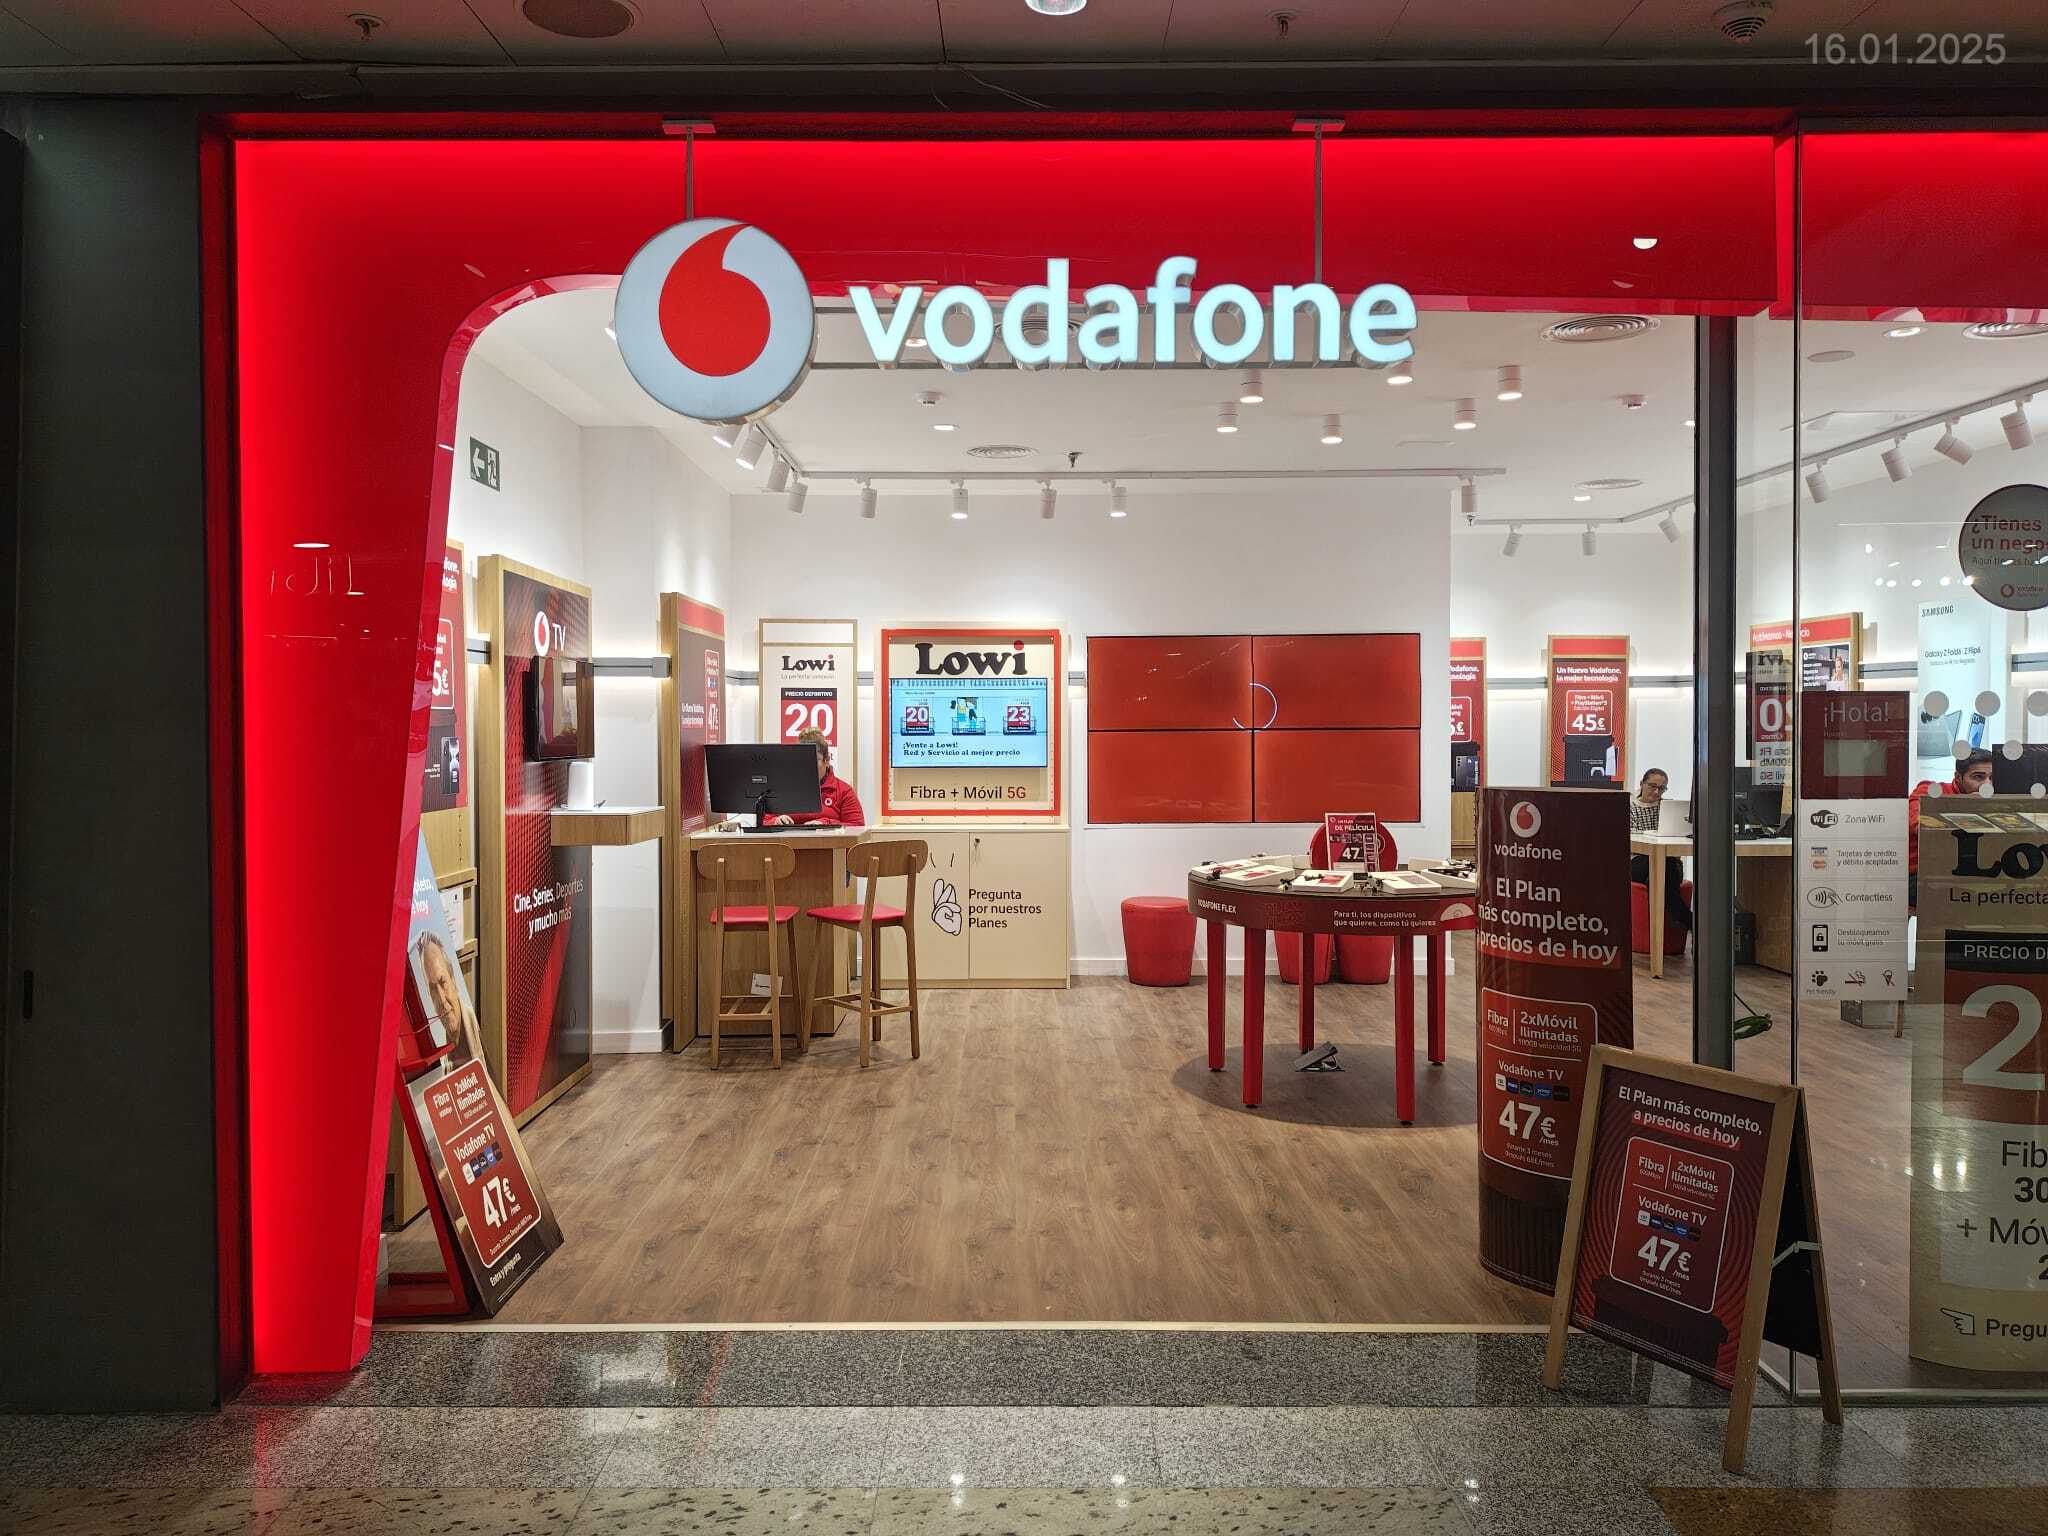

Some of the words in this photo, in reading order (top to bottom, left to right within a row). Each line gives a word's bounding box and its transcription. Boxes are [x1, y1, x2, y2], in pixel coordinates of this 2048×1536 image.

[847, 256, 1418, 368] vodafone
[1971, 515, 2042, 534] ¿Tienes
[1971, 537, 1994, 550] un
[1921, 604, 1954, 618] SAMSUNG
[551, 622, 566, 651] TV
[914, 639, 1029, 676] Lowi
[1924, 648, 1943, 658] Galaxy
[781, 654, 835, 671] Lowi
[1556, 666, 1567, 674] Un
[1567, 666, 1589, 674] Nuevo
[1589, 666, 1622, 675] Vodafone,
[1563, 674, 1583, 683] mejor
[1584, 674, 1619, 683] tecnología
[784, 703, 834, 738] 20
[906, 706, 930, 722] 20
[1008, 706, 1031, 722] 23
[1572, 713, 1606, 732] 45€
[1824, 701, 1889, 728] ¡Hola!
[903, 741, 928, 750] ¡Vente
[936, 741, 959, 749] Lowi!
[903, 749, 919, 757] Red
[920, 750, 926, 758] y
[927, 749, 960, 757] Servicio
[961, 749, 969, 757] al
[971, 749, 994, 759] mejor
[995, 749, 1021, 759] precio
[910, 785, 946, 799] Fibra
[950, 788, 960, 799] +
[963, 785, 1003, 799] Móvil
[1007, 786, 1027, 799] 5G
[1345, 823, 1375, 832] PELÍCULA
[1845, 815, 1866, 824] Zona
[1867, 814, 1886, 824] WiFi
[1342, 847, 1361, 860] 47
[1494, 843, 1563, 861] vodafone
[1837, 849, 1863, 859] Tarjetas
[1863, 849, 1872, 857] de
[1873, 848, 1897, 857] crédito
[1951, 828, 2048, 879] Lo
[1865, 859, 1899, 867] aceptadas
[514, 893, 533, 914] Cine,
[556, 879, 584, 901] Deportes
[969, 889, 1022, 902] Pregunta
[1496, 877, 1512, 898] El
[1515, 879, 1561, 903] Plan
[1845, 893, 1894, 902] Contactless
[1949, 887, 1972, 903] La
[969, 905, 990, 917] por
[991, 904, 1042, 915] nuestros
[1333, 910, 1350, 918] Para
[1373, 911, 1417, 920] dispositivos
[529, 918, 535, 940] y
[534, 908, 558, 933] mucho
[558, 903, 572, 923] más
[969, 917, 1008, 929] Planes
[1333, 919, 1348, 928] que
[1410, 919, 1437, 928] quieres
[1501, 910, 1609, 936] completo,
[1480, 930, 1534, 955] precios
[1538, 937, 1566, 958] de
[1572, 939, 1618, 966] hoy
[1963, 943, 2030, 961] PRECIO
[2035, 946, 2048, 961] D
[1487, 1008, 1509, 1027] Fibra
[1520, 1011, 1578, 1030] 2xMóvil
[1520, 1026, 1579, 1043] Ilimitadas
[1961, 984, 2047, 1091] 2
[1498, 1058, 1545, 1079] Vodafone
[1545, 1069, 1564, 1081] TV
[432, 1092, 450, 1110] Fibra
[1498, 1100, 1556, 1140] 47€
[1618, 1086, 1631, 1101] El
[1633, 1089, 1661, 1109] Plan
[1663, 1100, 1692, 1116] más
[1693, 1107, 1763, 1136] completo,
[1633, 1110, 1641, 1121] a
[1643, 1112, 1692, 1134] precios
[1693, 1123, 1711, 1139] de
[1712, 1127, 1740, 1149] hoy
[453, 1131, 488, 1162] Vodafone
[483, 1122, 496, 1141] TV
[1539, 1136, 1560, 1146] /mes
[2002, 1140, 2048, 1169] Fib
[1638, 1156, 1665, 1174] Fibra
[1676, 1161, 1716, 1182] 2xMóvil
[1671, 1171, 1719, 1194] Ilimitadas
[1638, 1195, 1689, 1222] Vodafone
[1691, 1211, 1708, 1226] TV
[1956, 1218, 1978, 1238] +
[1637, 1235, 1692, 1273] 47€
[1672, 1269, 1690, 1281] /mes
[1986, 1318, 2048, 1342] Pregu
